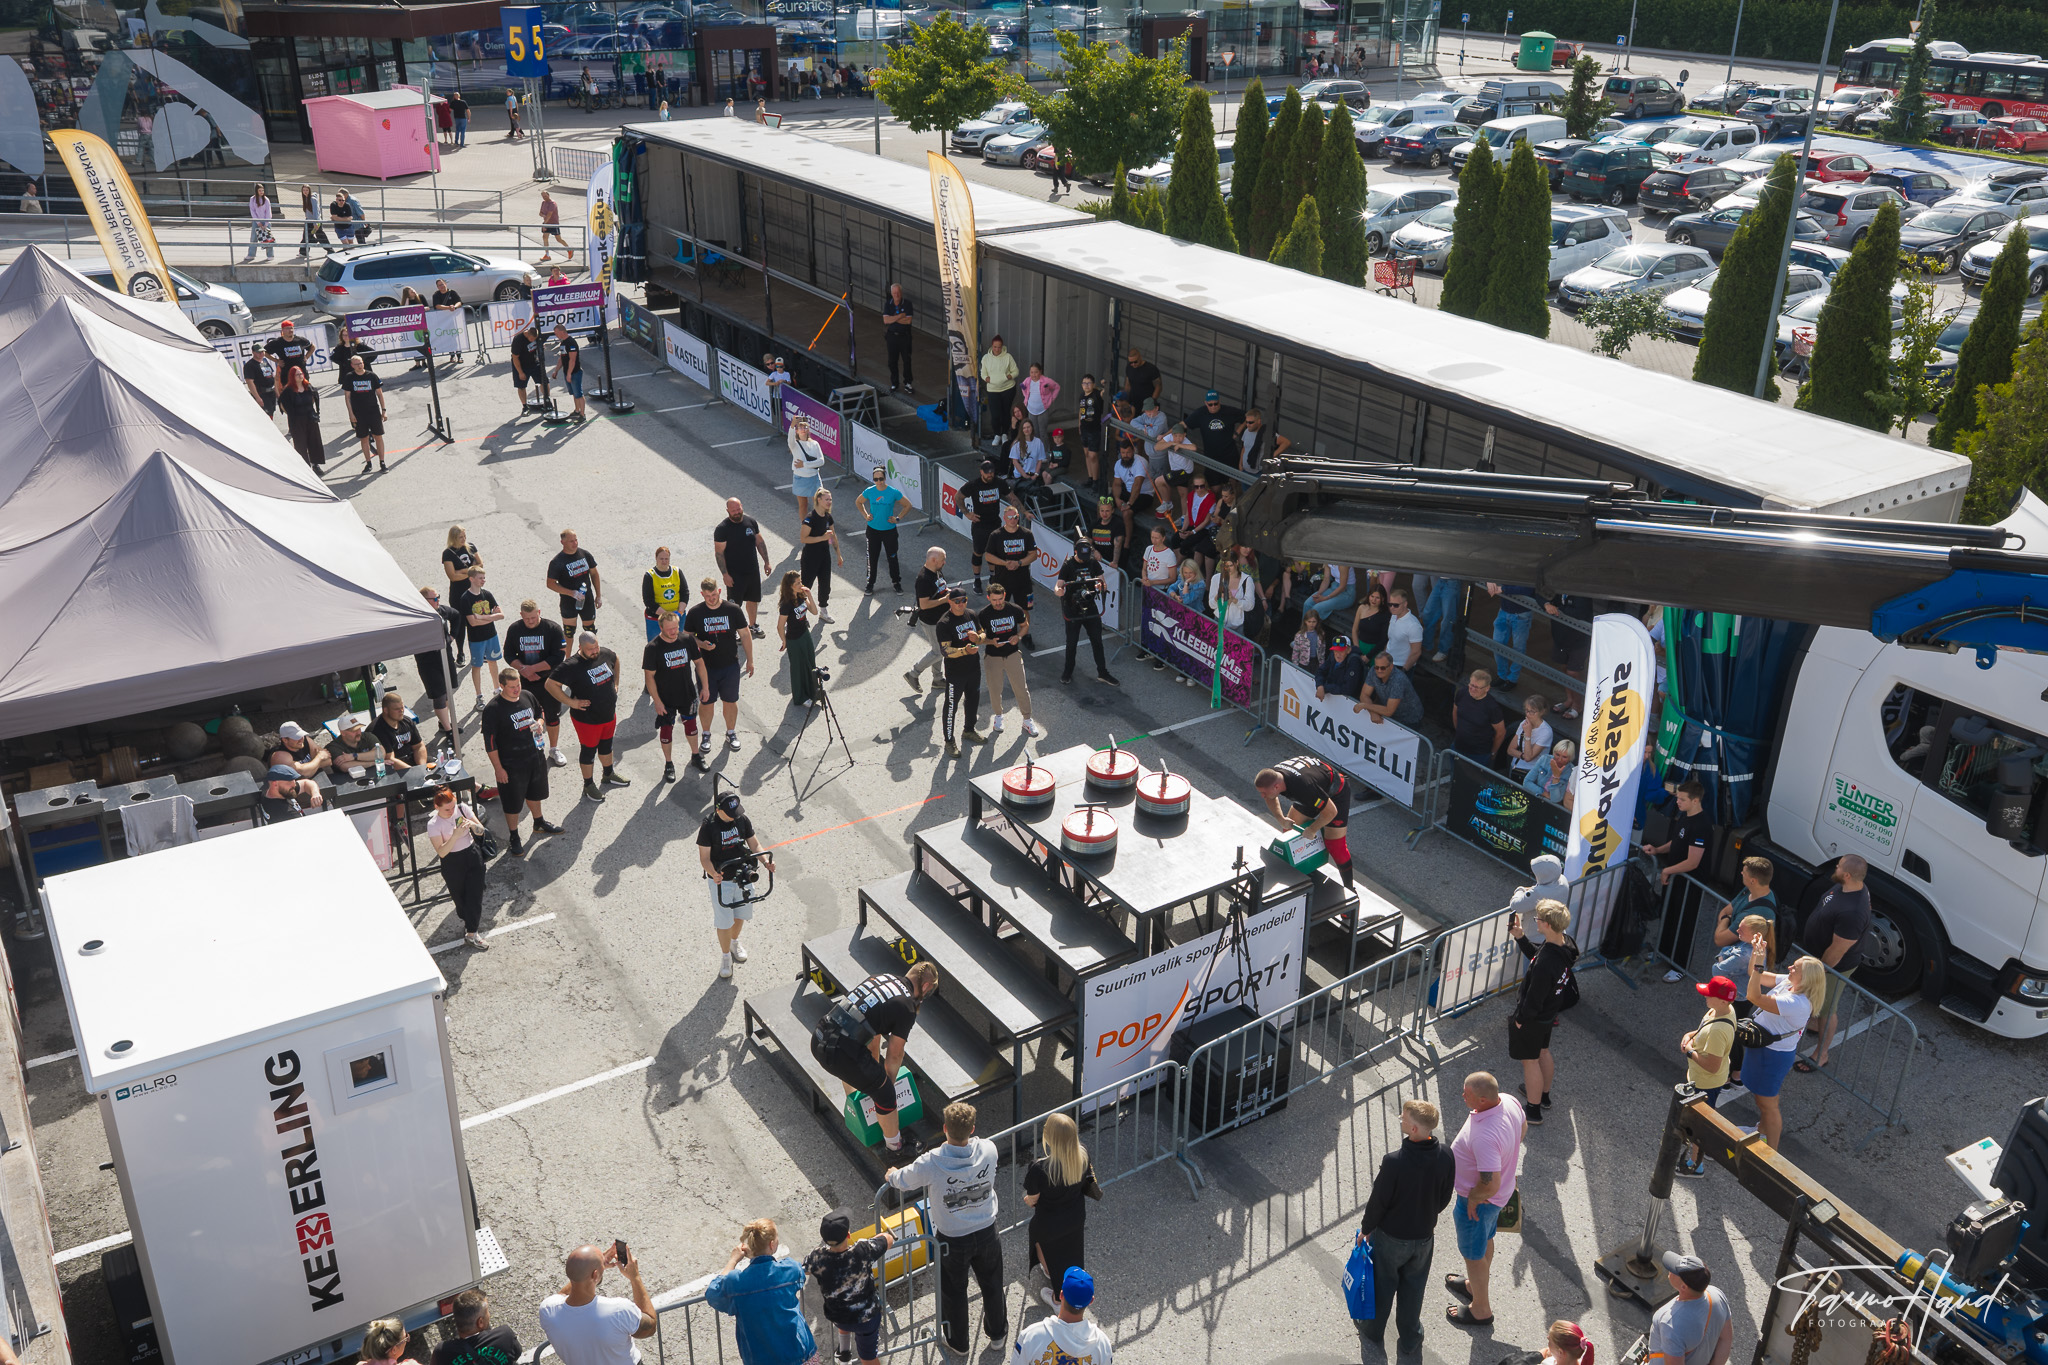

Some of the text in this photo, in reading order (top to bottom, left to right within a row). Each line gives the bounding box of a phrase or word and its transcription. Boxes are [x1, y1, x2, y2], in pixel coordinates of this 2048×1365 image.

[777, 0, 833, 13] euronics
[509, 26, 525, 61] 5
[532, 25, 544, 61] 5
[553, 290, 600, 302] KLEEBIKUM
[370, 313, 422, 327] KLEEBIKUM
[494, 318, 525, 333] POP
[674, 343, 708, 375] KASTELLI
[730, 362, 758, 392] EESTI
[732, 381, 771, 417] HALDUS
[943, 491, 955, 508] 24
[1306, 704, 1412, 784] KASTELLI
[1471, 816, 1523, 851] ATHLETE
[1836, 818, 1891, 846] +372 51 22 459
[1839, 809, 1857, 821] +372
[1863, 820, 1878, 831] 409
[1878, 826, 1893, 838] 090
[1480, 829, 1510, 849] BYTES
[1094, 971, 1146, 998] Suurim
[1151, 955, 1183, 977] valik
[1095, 953, 1290, 1058] POP SPORT!
[131, 1074, 177, 1095] ALRO
[131, 1347, 159, 1364] ALRO
